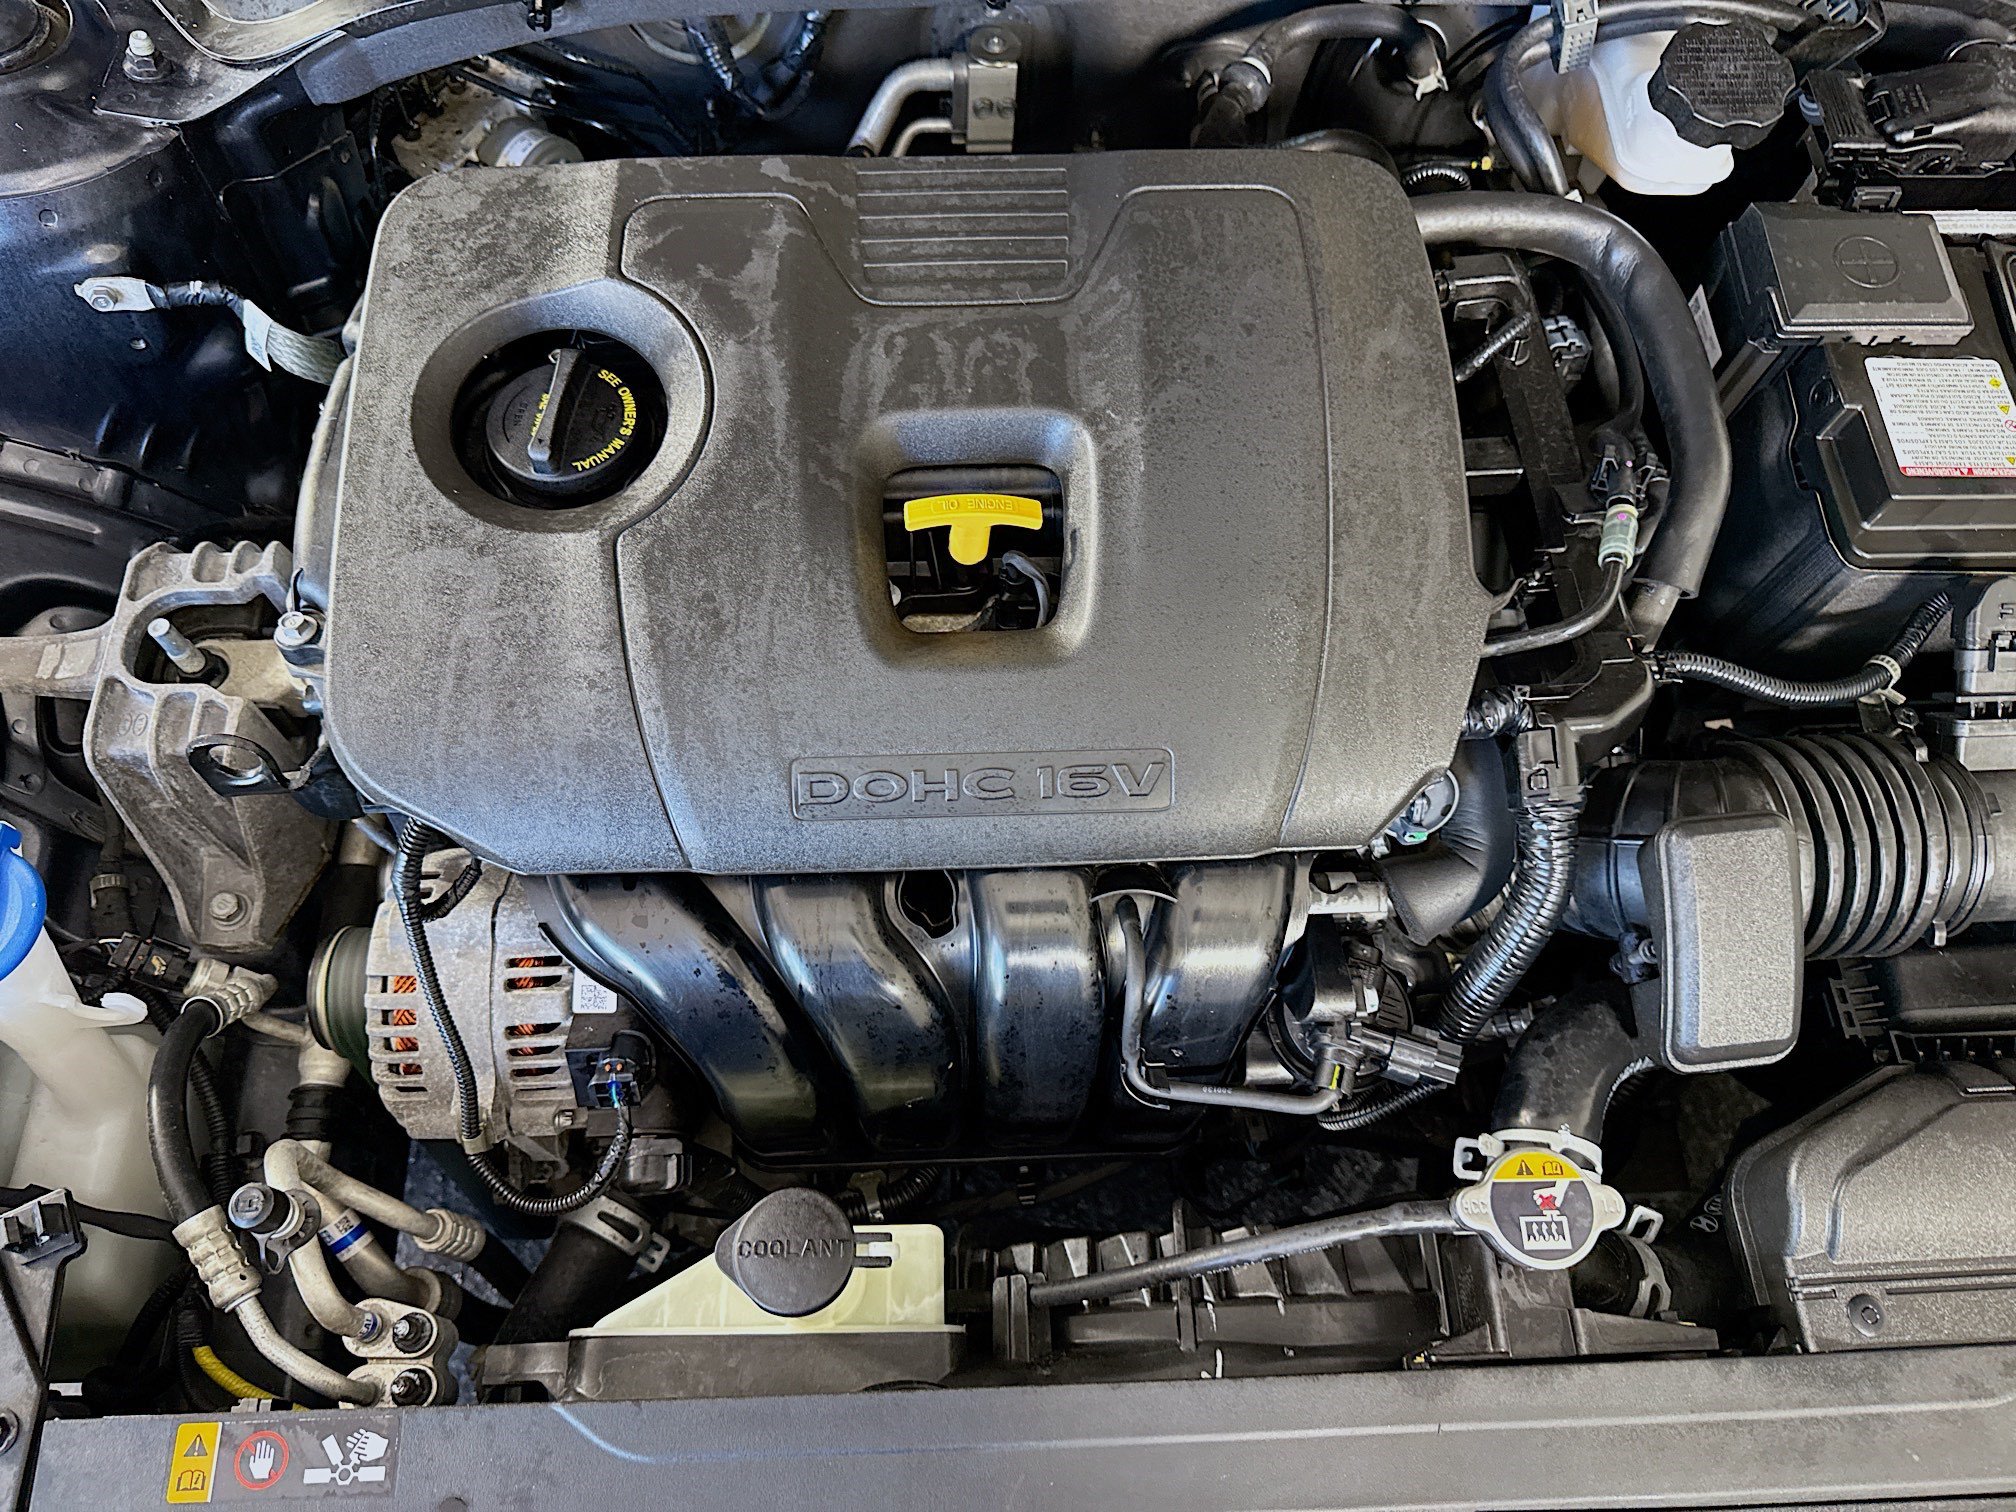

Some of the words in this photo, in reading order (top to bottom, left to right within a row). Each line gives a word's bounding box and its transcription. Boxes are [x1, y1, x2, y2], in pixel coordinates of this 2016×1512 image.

[598, 369, 622, 388] SEE
[617, 386, 637, 436] OWNER'S
[571, 437, 626, 472] MANUAL
[938, 500, 959, 511] OIL
[968, 499, 1013, 511] ENGINE
[798, 767, 1016, 806] DOHC
[1035, 762, 1165, 799] 16V
[738, 1238, 850, 1259] COOLANT
